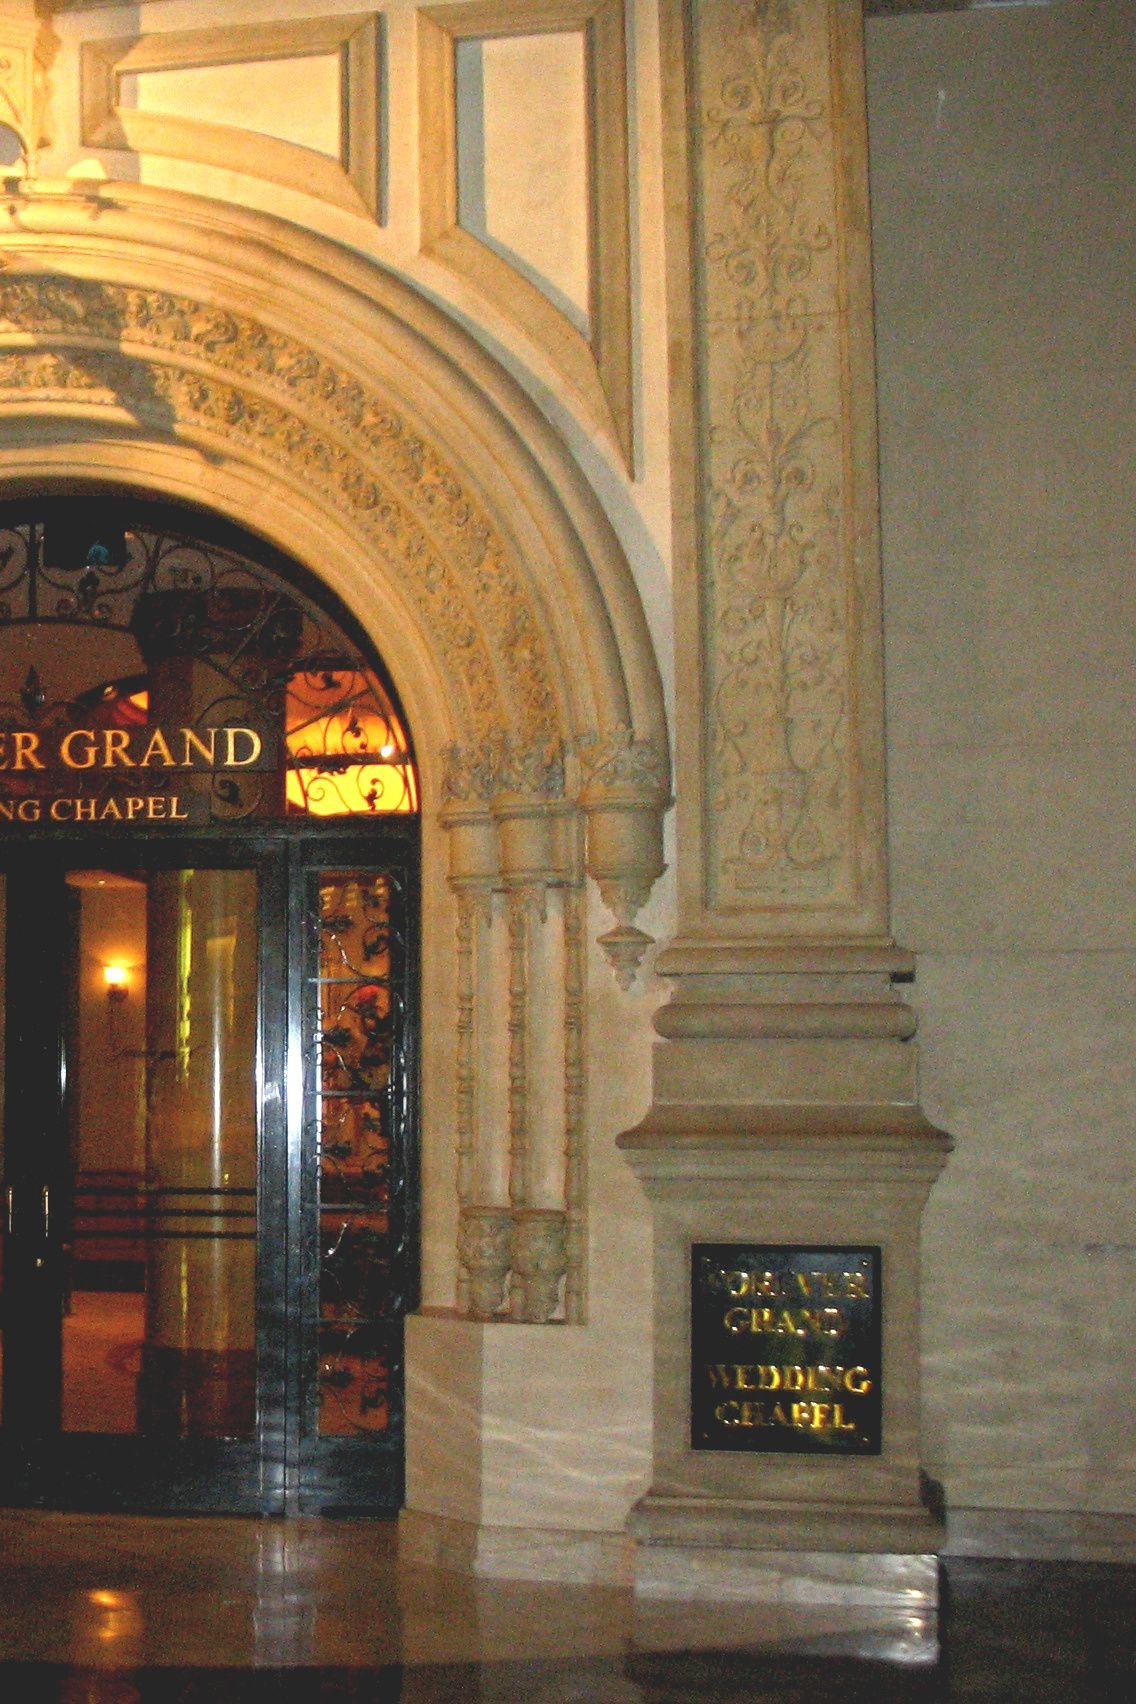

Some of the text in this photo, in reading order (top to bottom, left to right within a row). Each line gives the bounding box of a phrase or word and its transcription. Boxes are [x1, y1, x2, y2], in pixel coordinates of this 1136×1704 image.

[60, 727, 262, 769] GRAND
[51, 797, 189, 821] CHAPEL
[707, 1270, 870, 1298] ORVER
[724, 1307, 848, 1337] GRAND
[706, 1364, 872, 1393] WEDDING
[715, 1402, 856, 1429] CHAPEL
